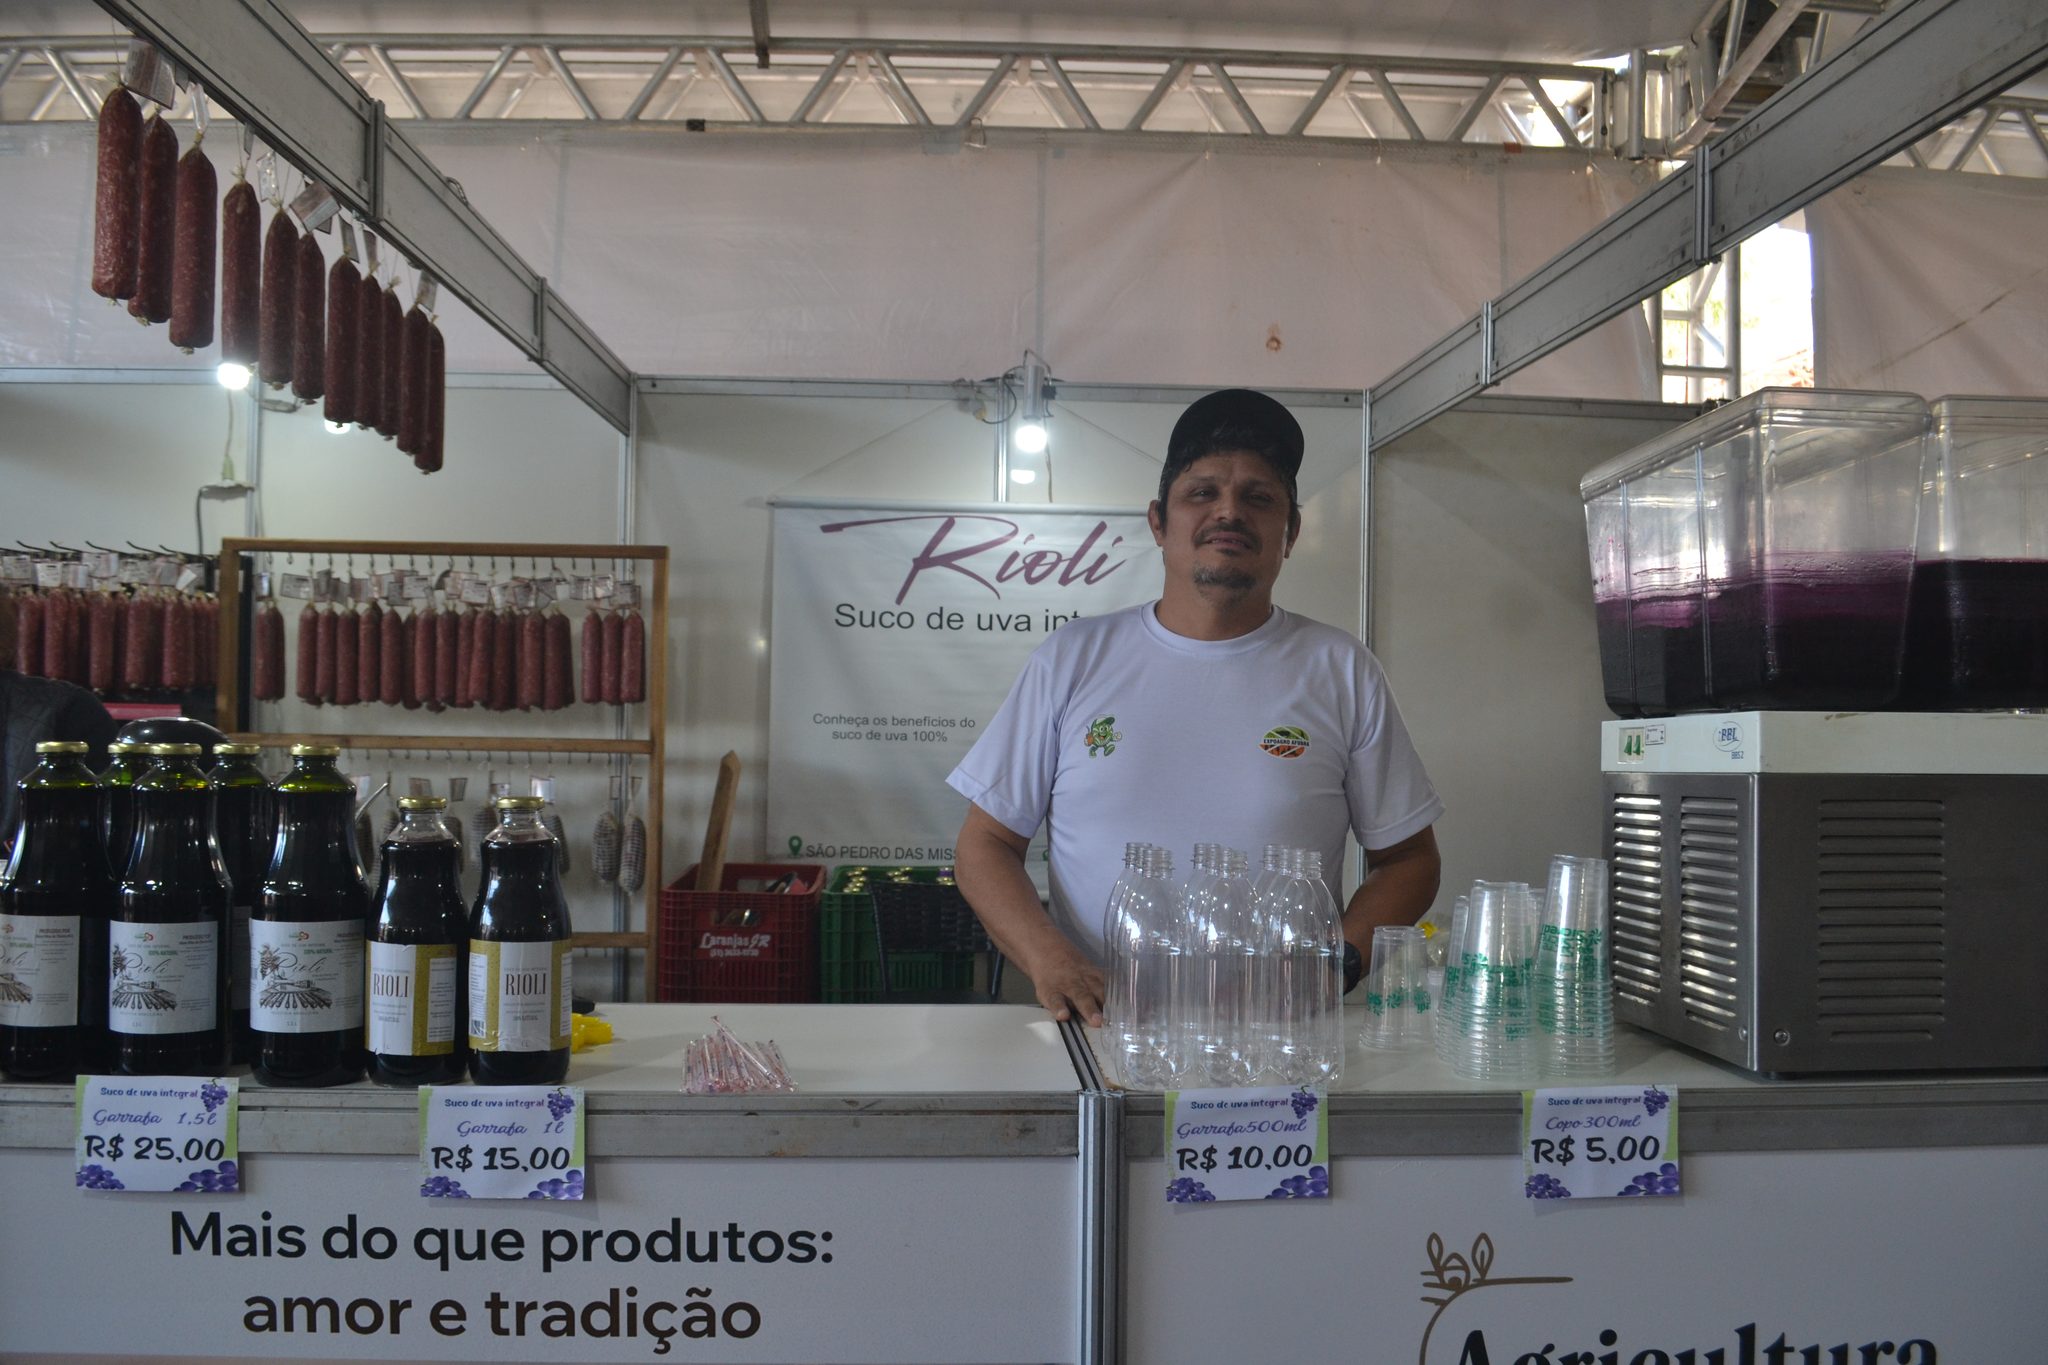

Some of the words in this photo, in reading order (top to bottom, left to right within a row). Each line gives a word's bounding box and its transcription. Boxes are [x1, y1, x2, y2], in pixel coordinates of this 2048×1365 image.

[820, 515, 1127, 605] Rioli
[834, 603, 915, 630] Suco
[926, 606, 964, 631] de
[976, 612, 1031, 632] uva
[812, 713, 869, 727] Conheça
[873, 718, 888, 727] os
[959, 716, 976, 728] do
[832, 731, 862, 741] suco
[865, 730, 881, 741] de
[885, 732, 908, 742] uva
[913, 730, 948, 743] 100%
[806, 843, 836, 858] SÃO
[840, 846, 891, 859] PEDRO
[895, 847, 924, 860] DAS
[928, 848, 956, 860] MIS
[700, 932, 749, 949] Laranjas
[373, 973, 409, 998] RIOLI
[505, 973, 547, 996] RIOLI
[100, 1087, 123, 1096] Suco
[126, 1088, 138, 1096] de
[160, 1089, 198, 1099] integral
[1548, 1098, 1570, 1106] Suco
[1573, 1097, 1583, 1105] de
[1605, 1096, 1641, 1106] integral
[444, 1099, 468, 1107] Suco
[471, 1099, 482, 1107] de
[505, 1099, 544, 1109] integral
[1191, 1101, 1214, 1109] Suco
[1216, 1100, 1228, 1109] de
[1250, 1098, 1289, 1109] integral
[93, 1109, 162, 1126] Garrafa
[456, 1120, 528, 1137] Garrafa
[84, 1133, 125, 1162] R$
[134, 1136, 225, 1163] 25,00
[1531, 1135, 1575, 1166] R$
[1586, 1135, 1660, 1164] 5,00
[431, 1144, 473, 1173] R$
[483, 1147, 570, 1172] 15,00
[1176, 1144, 1218, 1173] R$
[1227, 1144, 1313, 1170] 10,00
[171, 1210, 306, 1258] Mais
[320, 1213, 398, 1260] do
[412, 1225, 526, 1272] que
[541, 1217, 834, 1272] produtos:
[242, 1293, 412, 1334] amor
[429, 1298, 467, 1337] e
[482, 1286, 762, 1355] tradição
